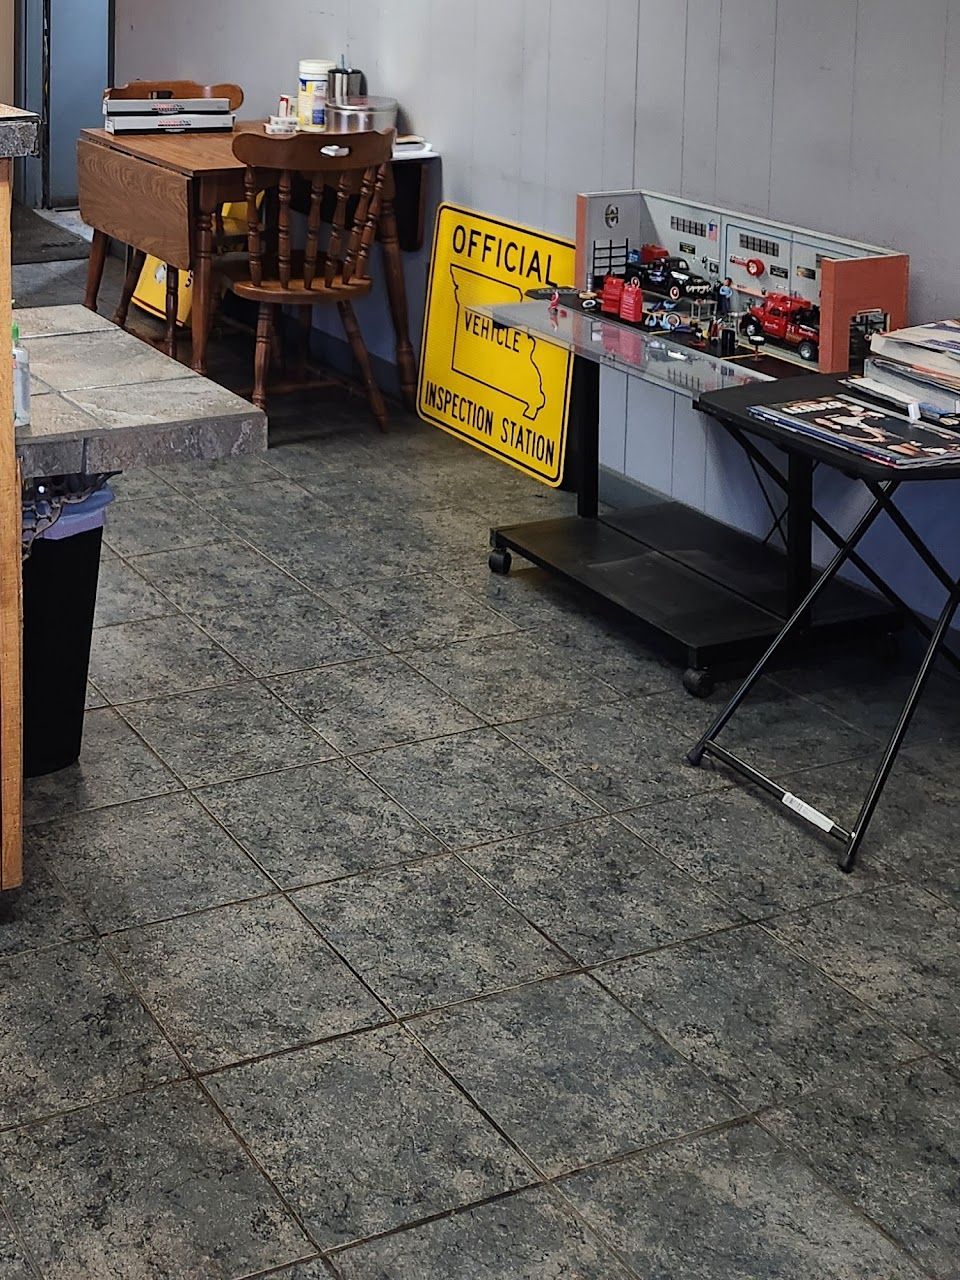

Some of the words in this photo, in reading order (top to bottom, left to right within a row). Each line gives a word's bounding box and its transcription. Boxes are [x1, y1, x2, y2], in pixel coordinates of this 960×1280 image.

[452, 224, 558, 287] OFFICIAL
[464, 310, 520, 353] VEHICLE
[424, 380, 494, 437] INSPECTION
[500, 417, 555, 467] STATION
